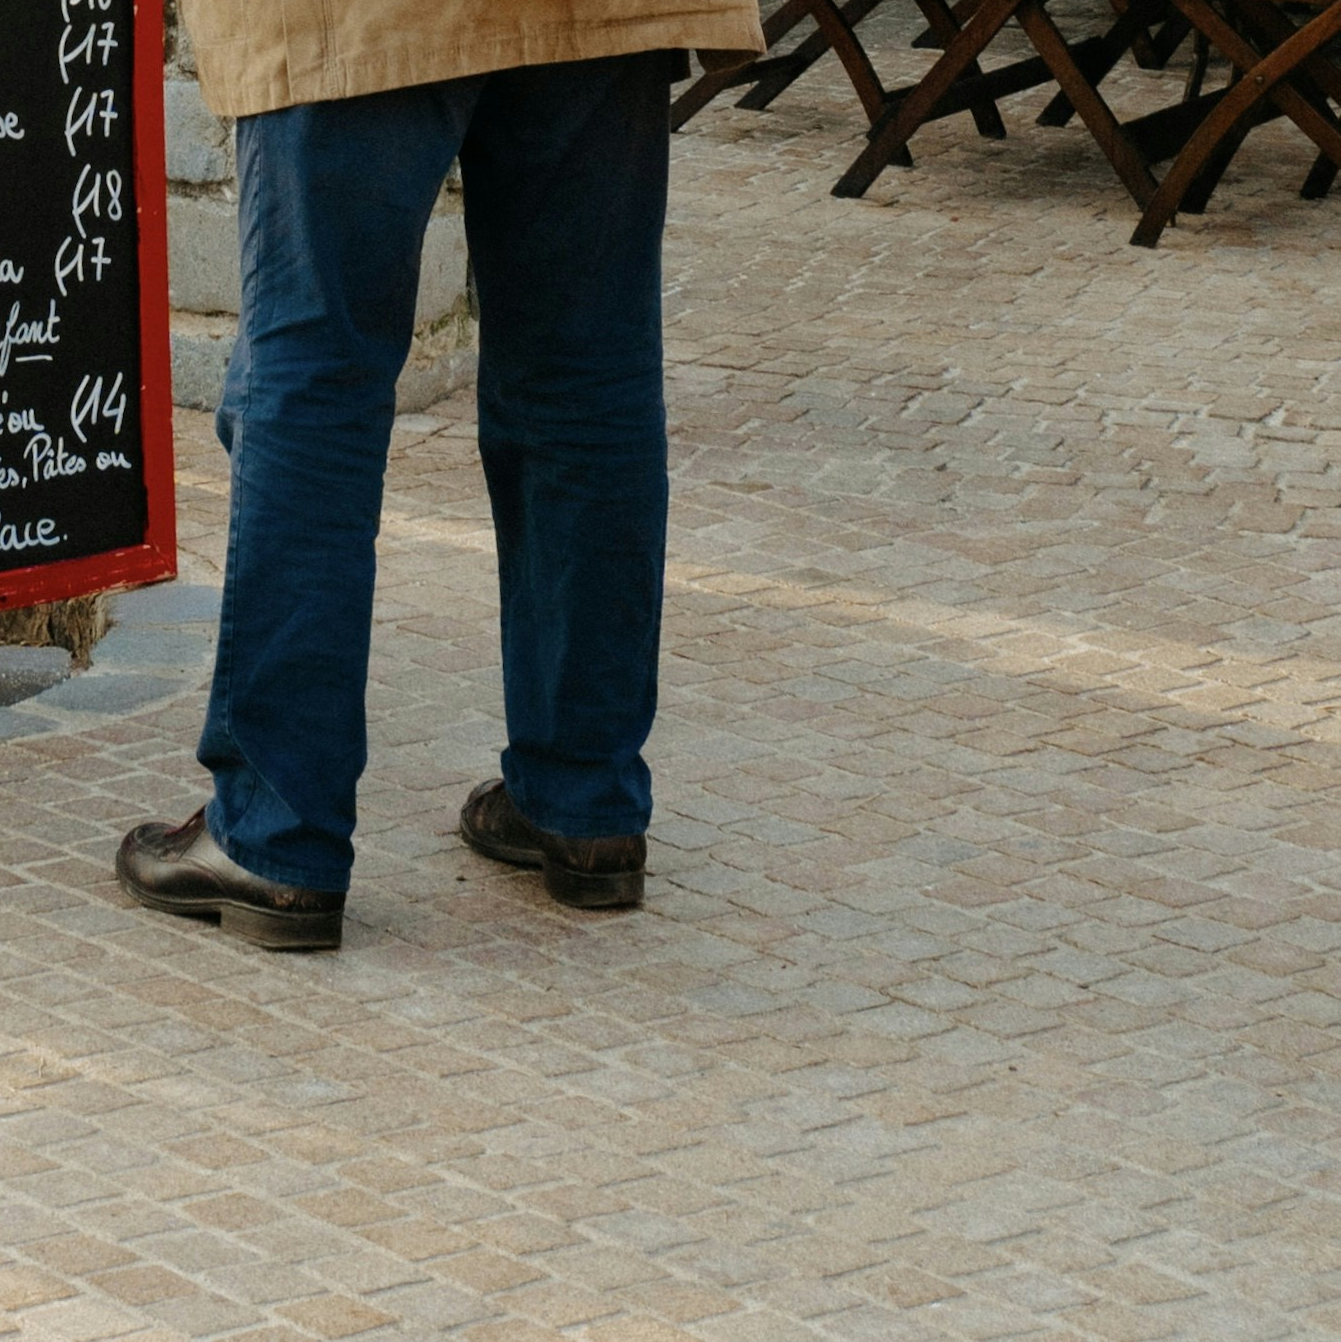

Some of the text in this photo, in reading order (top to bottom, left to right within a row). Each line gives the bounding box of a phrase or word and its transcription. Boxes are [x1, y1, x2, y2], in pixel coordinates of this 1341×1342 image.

[7, 408, 45, 433] ou
[23, 432, 87, 484] Pâtes
[95, 450, 133, 471] ou
